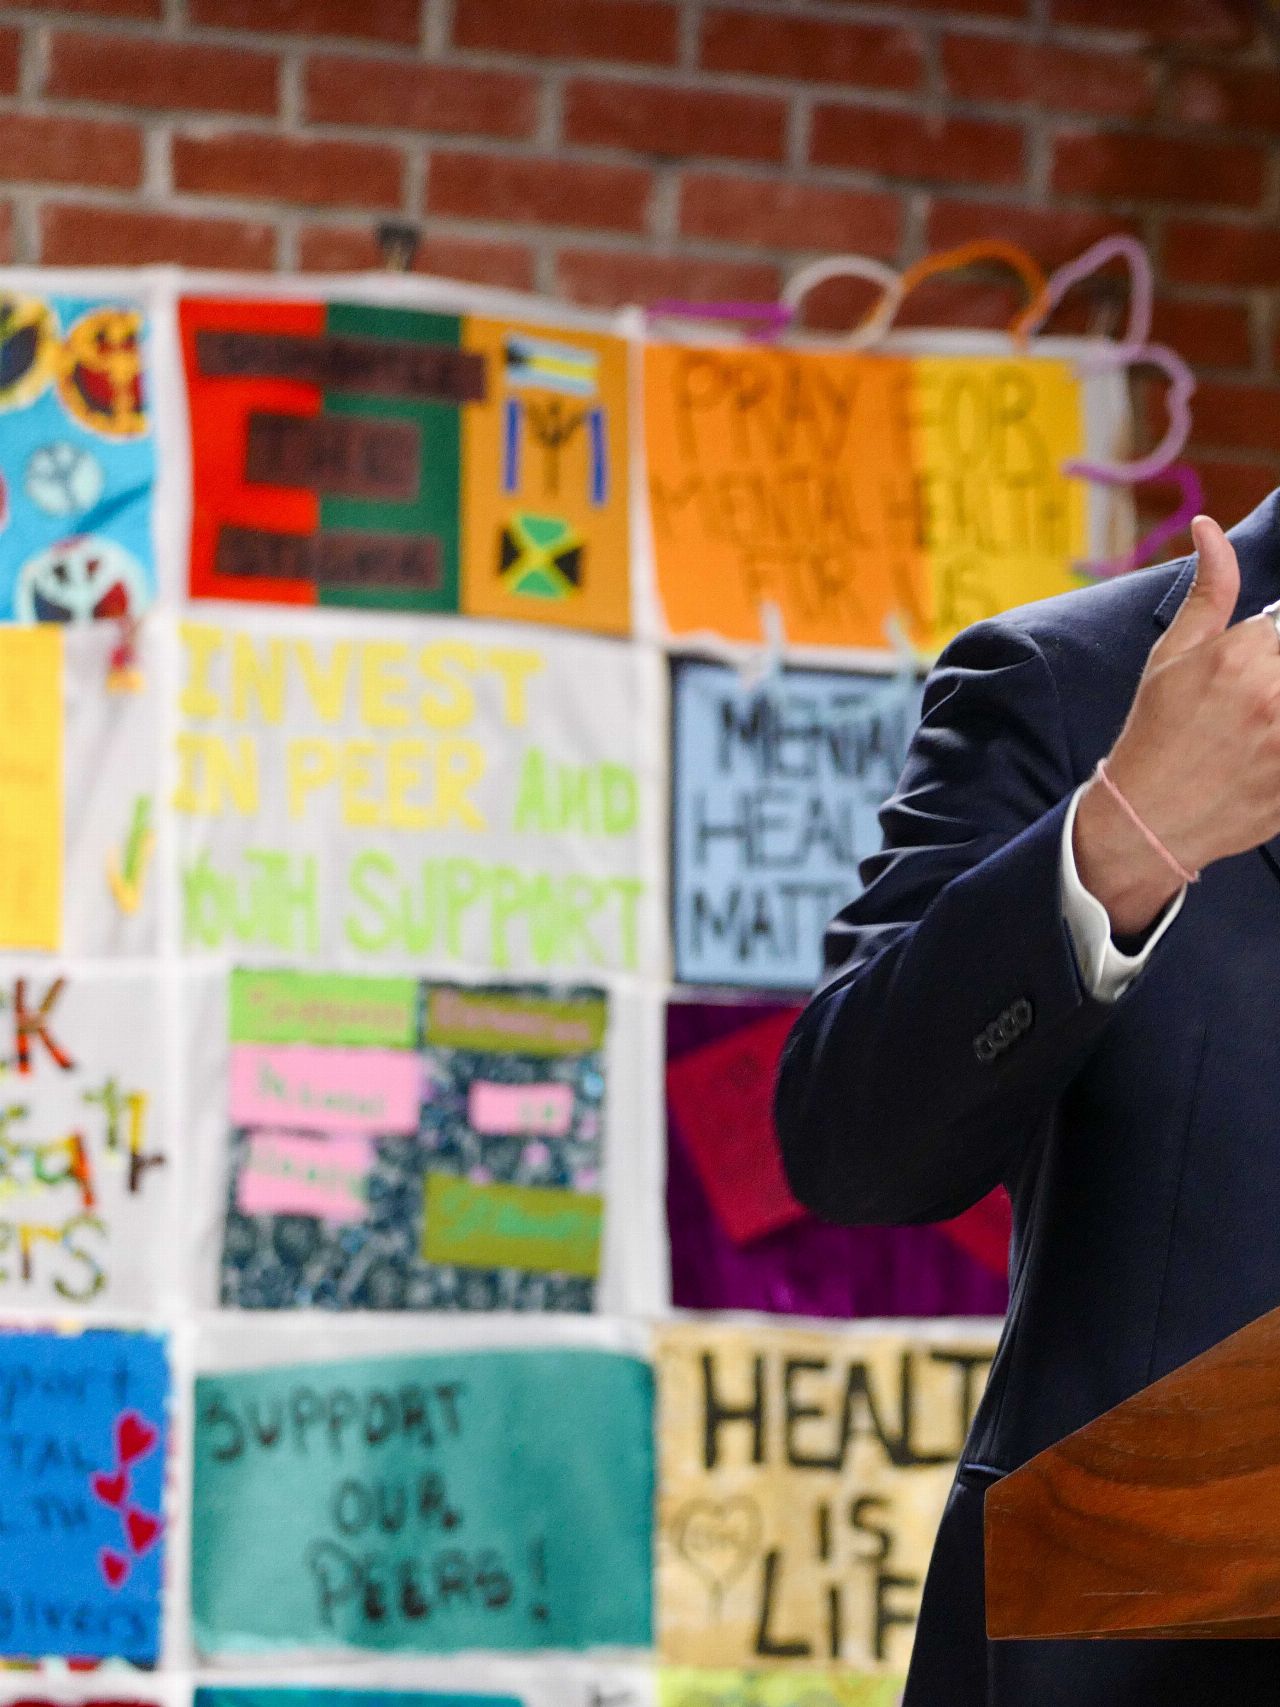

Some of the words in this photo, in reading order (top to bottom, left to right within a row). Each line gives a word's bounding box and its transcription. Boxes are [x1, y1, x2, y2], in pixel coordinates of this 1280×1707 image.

[177, 622, 545, 730] INVEST
[172, 732, 259, 815] IN
[286, 738, 488, 833] PEER
[514, 747, 642, 837] AND
[344, 848, 644, 970] SUPPORT
[0, 977, 76, 1076] K
[200, 1379, 465, 1462] SUPPORT
[333, 1472, 459, 1537] OUR
[817, 1494, 893, 1562] IS
